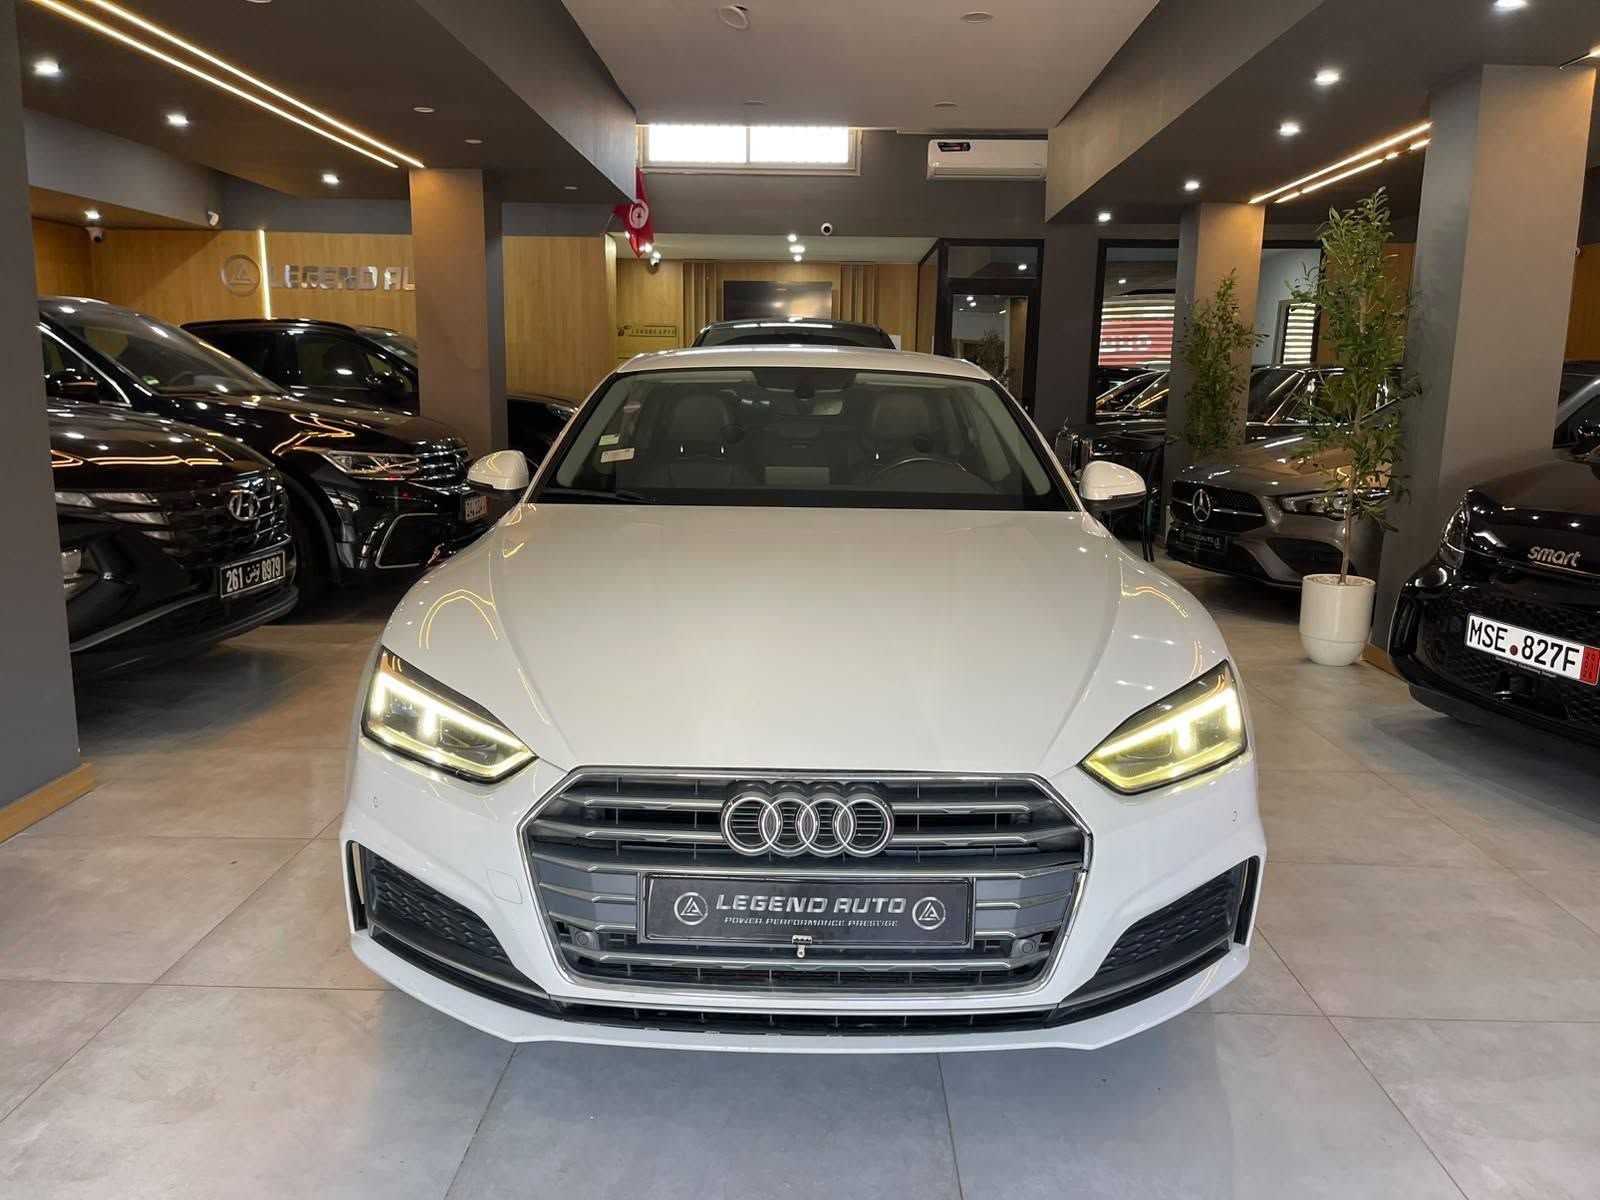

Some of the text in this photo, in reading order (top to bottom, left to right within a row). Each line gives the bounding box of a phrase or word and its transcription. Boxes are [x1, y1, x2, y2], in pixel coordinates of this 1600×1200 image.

[270, 264, 378, 290] LEGEND
[1527, 546, 1581, 567] smart
[226, 567, 243, 593] 261
[1469, 619, 1508, 653] MSE
[1521, 635, 1579, 671] 827F
[716, 894, 907, 914] LEGEND AUTO
[724, 916, 763, 925] POWER
